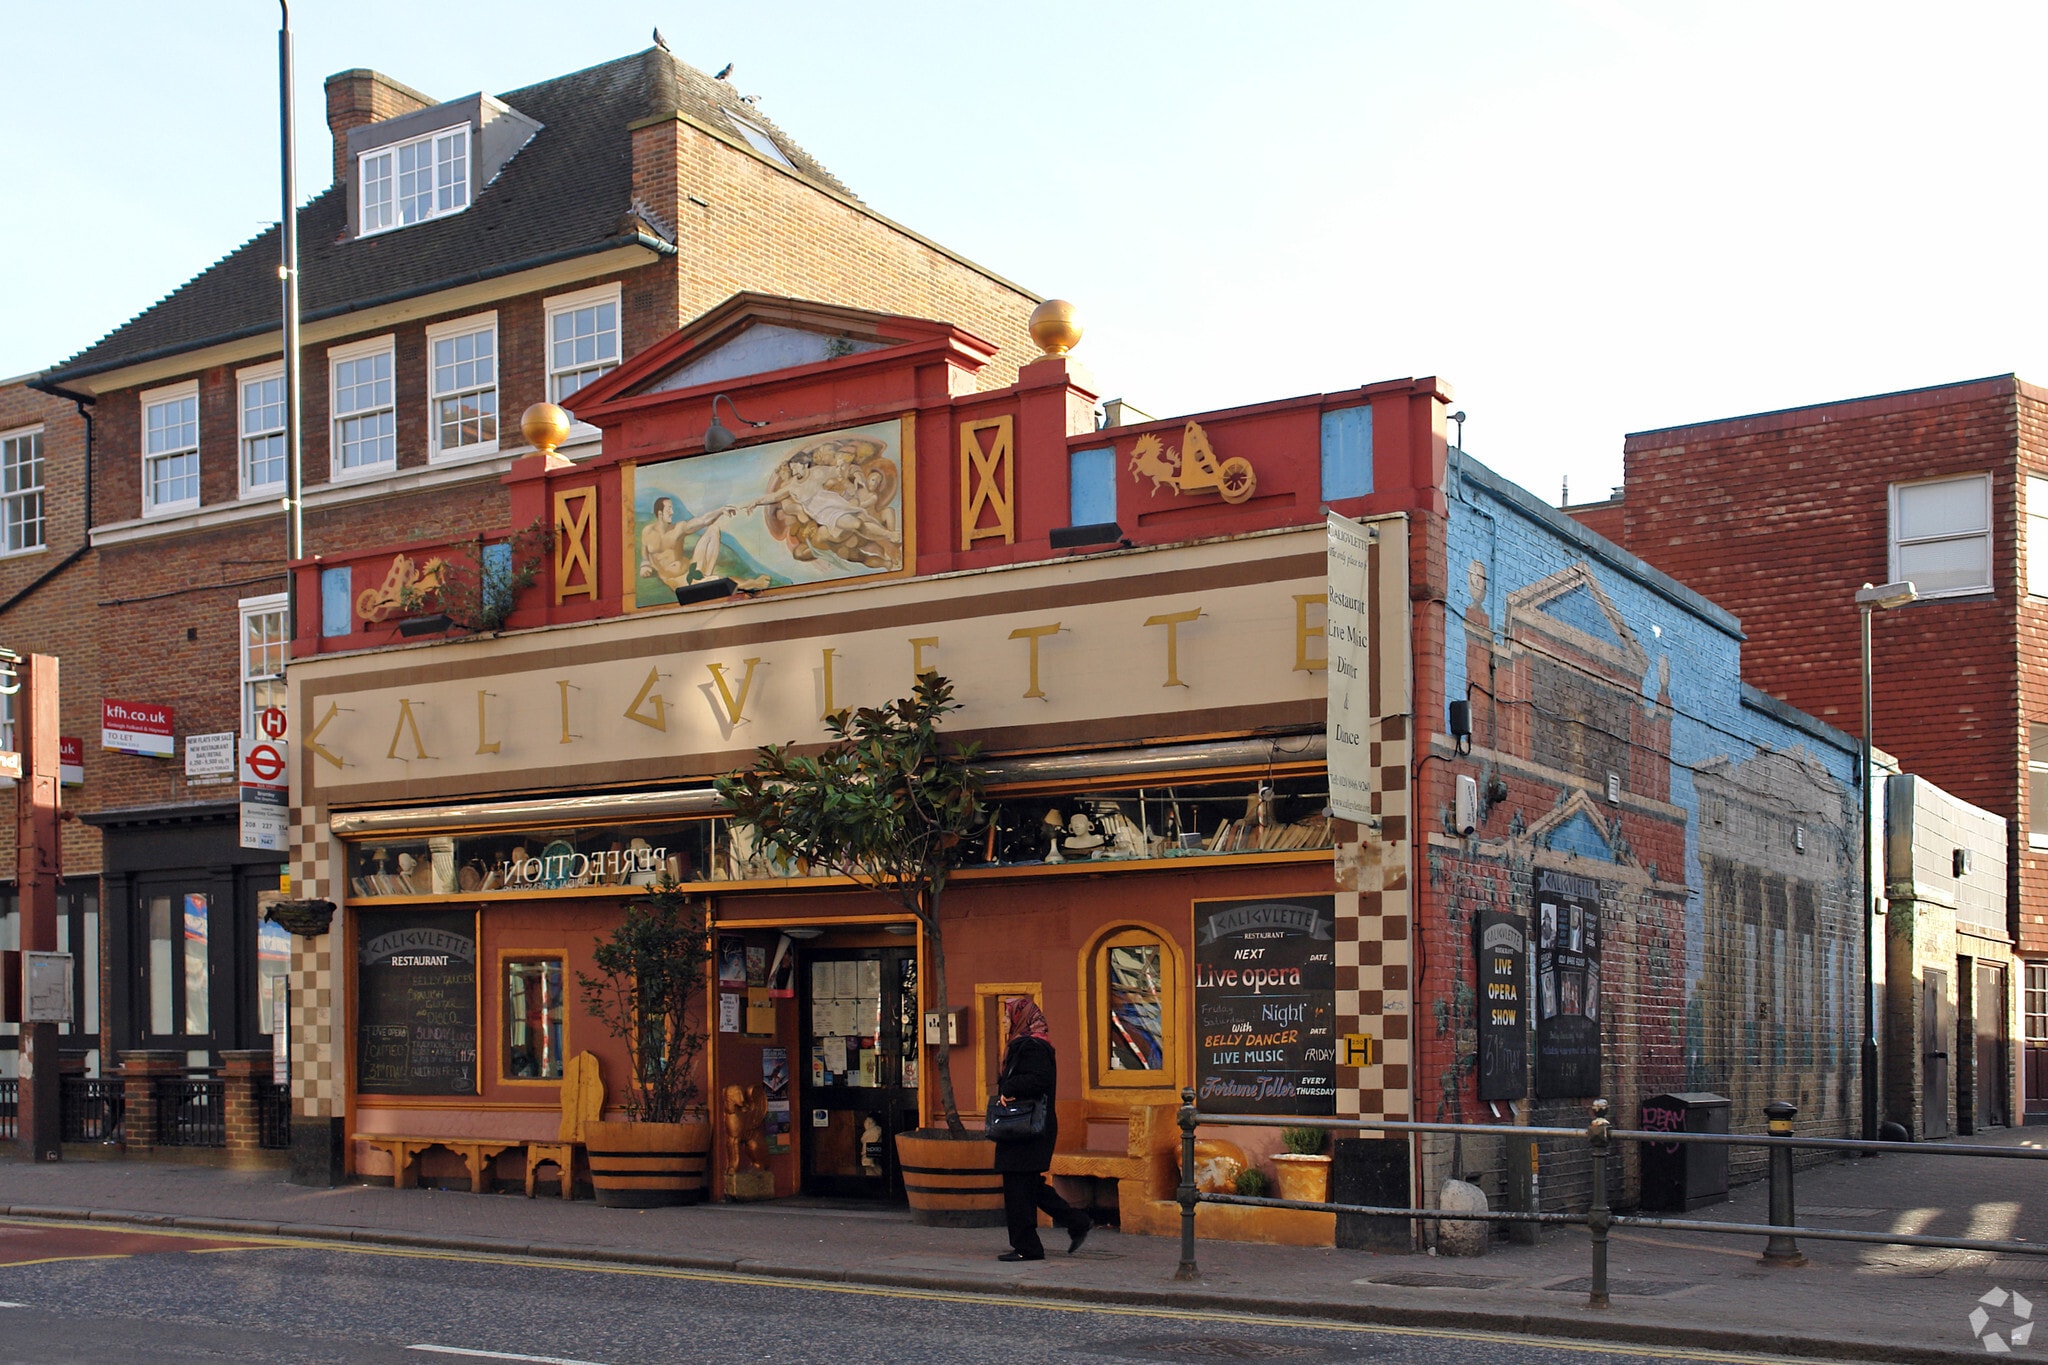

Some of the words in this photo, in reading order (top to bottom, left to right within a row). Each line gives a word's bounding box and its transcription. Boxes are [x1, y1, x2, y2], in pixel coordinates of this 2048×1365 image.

[1328, 619, 1345, 641] Live
[107, 704, 165, 724] kfh.co.uk
[107, 731, 119, 741] TO
[120, 733, 134, 743] LET
[1244, 932, 1285, 940] RESTAURANT
[391, 955, 449, 966] RESTAURANT
[1234, 949, 1265, 960] NEXT
[1309, 954, 1328, 962] DATE
[1495, 959, 1512, 976] LIVE
[1196, 964, 1238, 988] Live
[1242, 967, 1300, 994] opera
[1488, 983, 1517, 1001] OPERA
[1261, 1003, 1305, 1028] Night
[1492, 1009, 1517, 1026] SHOW
[1205, 1034, 1242, 1048] BELLY
[1245, 1030, 1299, 1047] DANCER
[1213, 1051, 1240, 1065] LIVE
[1244, 1050, 1284, 1062] MUSIC
[1305, 1048, 1335, 1061] FRIDAY
[1200, 1075, 1258, 1098] Fortune
[1255, 1075, 1296, 1100] Teller
[1301, 1077, 1327, 1085] EVERY
[1296, 1087, 1335, 1096] THURSDAY
